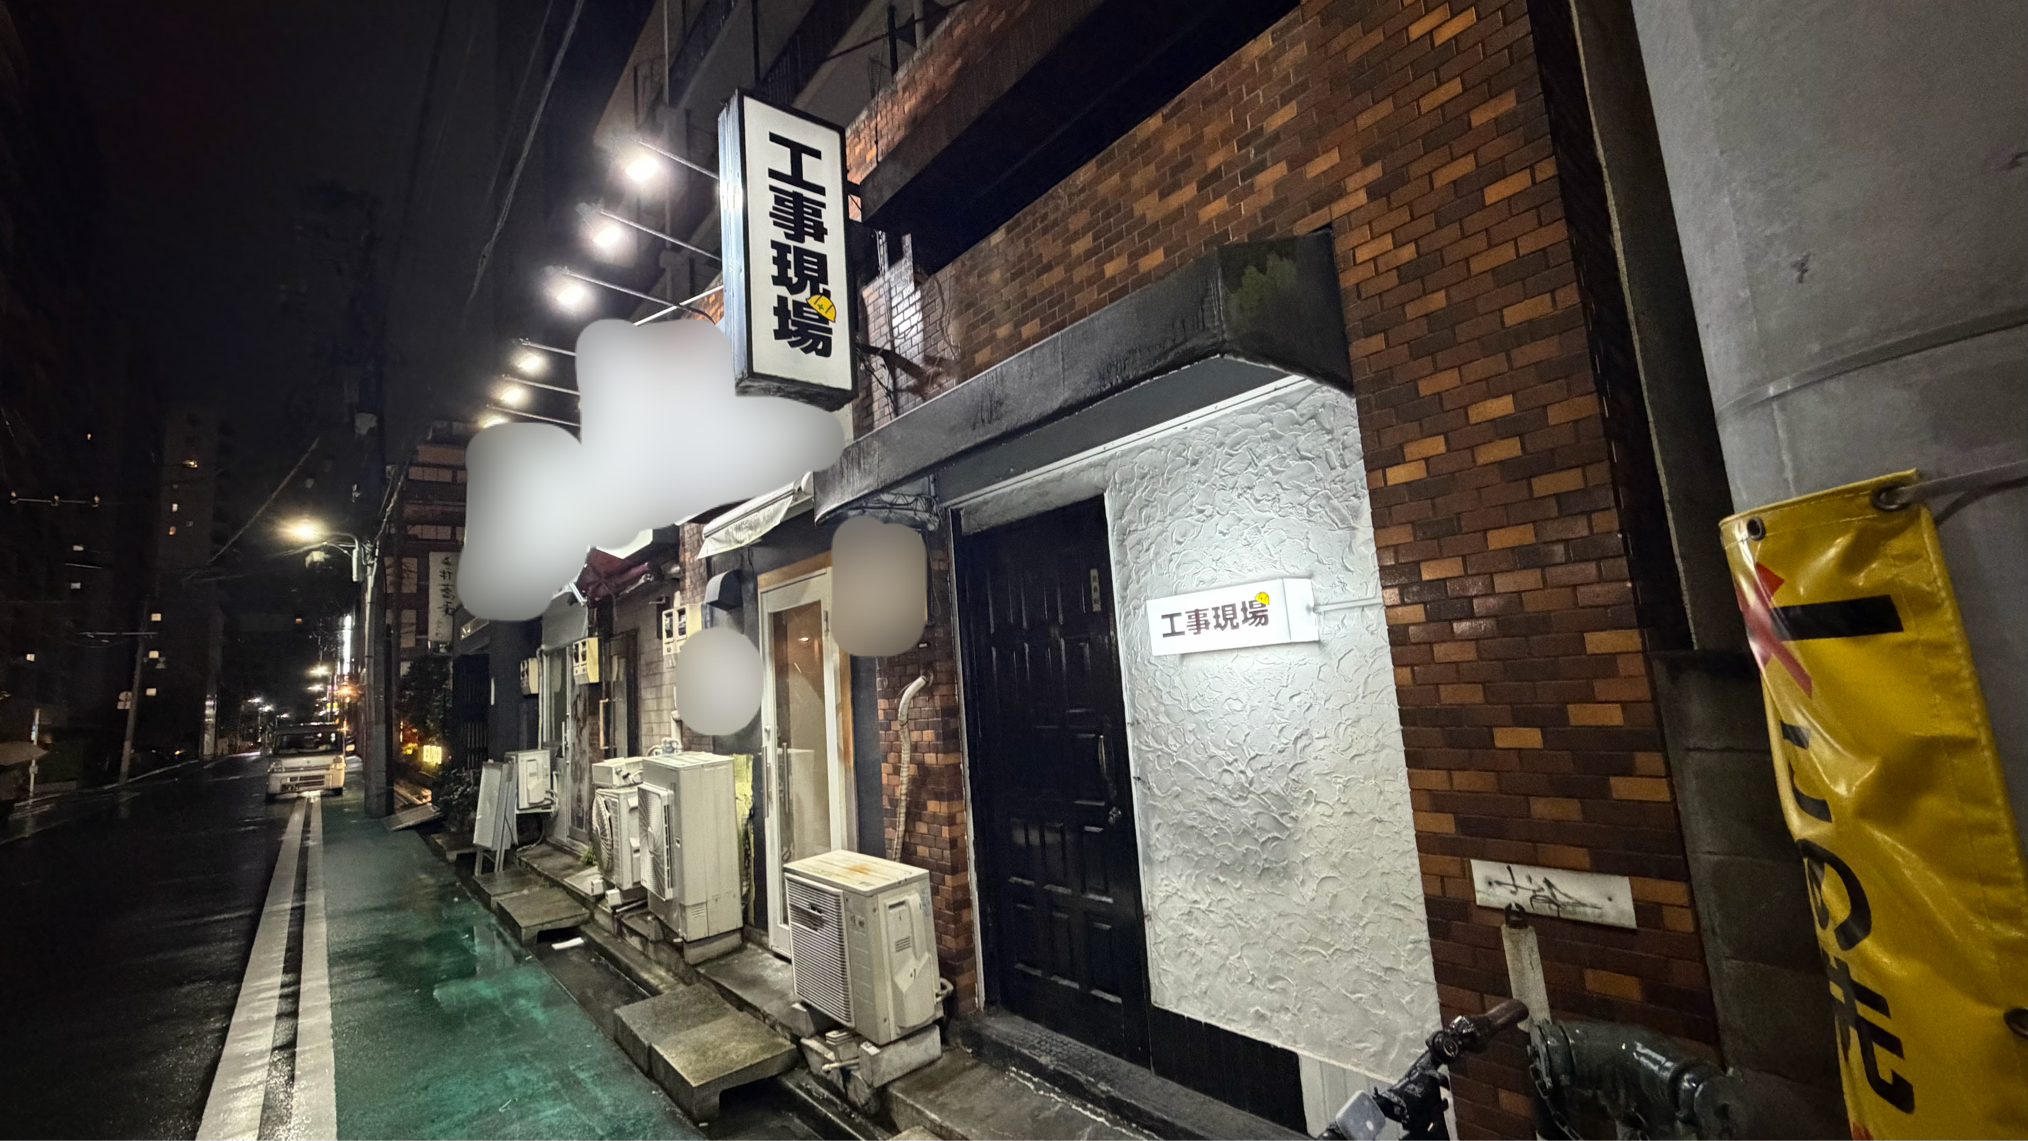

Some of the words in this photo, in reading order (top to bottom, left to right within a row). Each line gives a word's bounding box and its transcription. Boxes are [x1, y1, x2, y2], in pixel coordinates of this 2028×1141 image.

[768, 131, 833, 358] 工事現場
[1161, 600, 1269, 638] 工事現場
